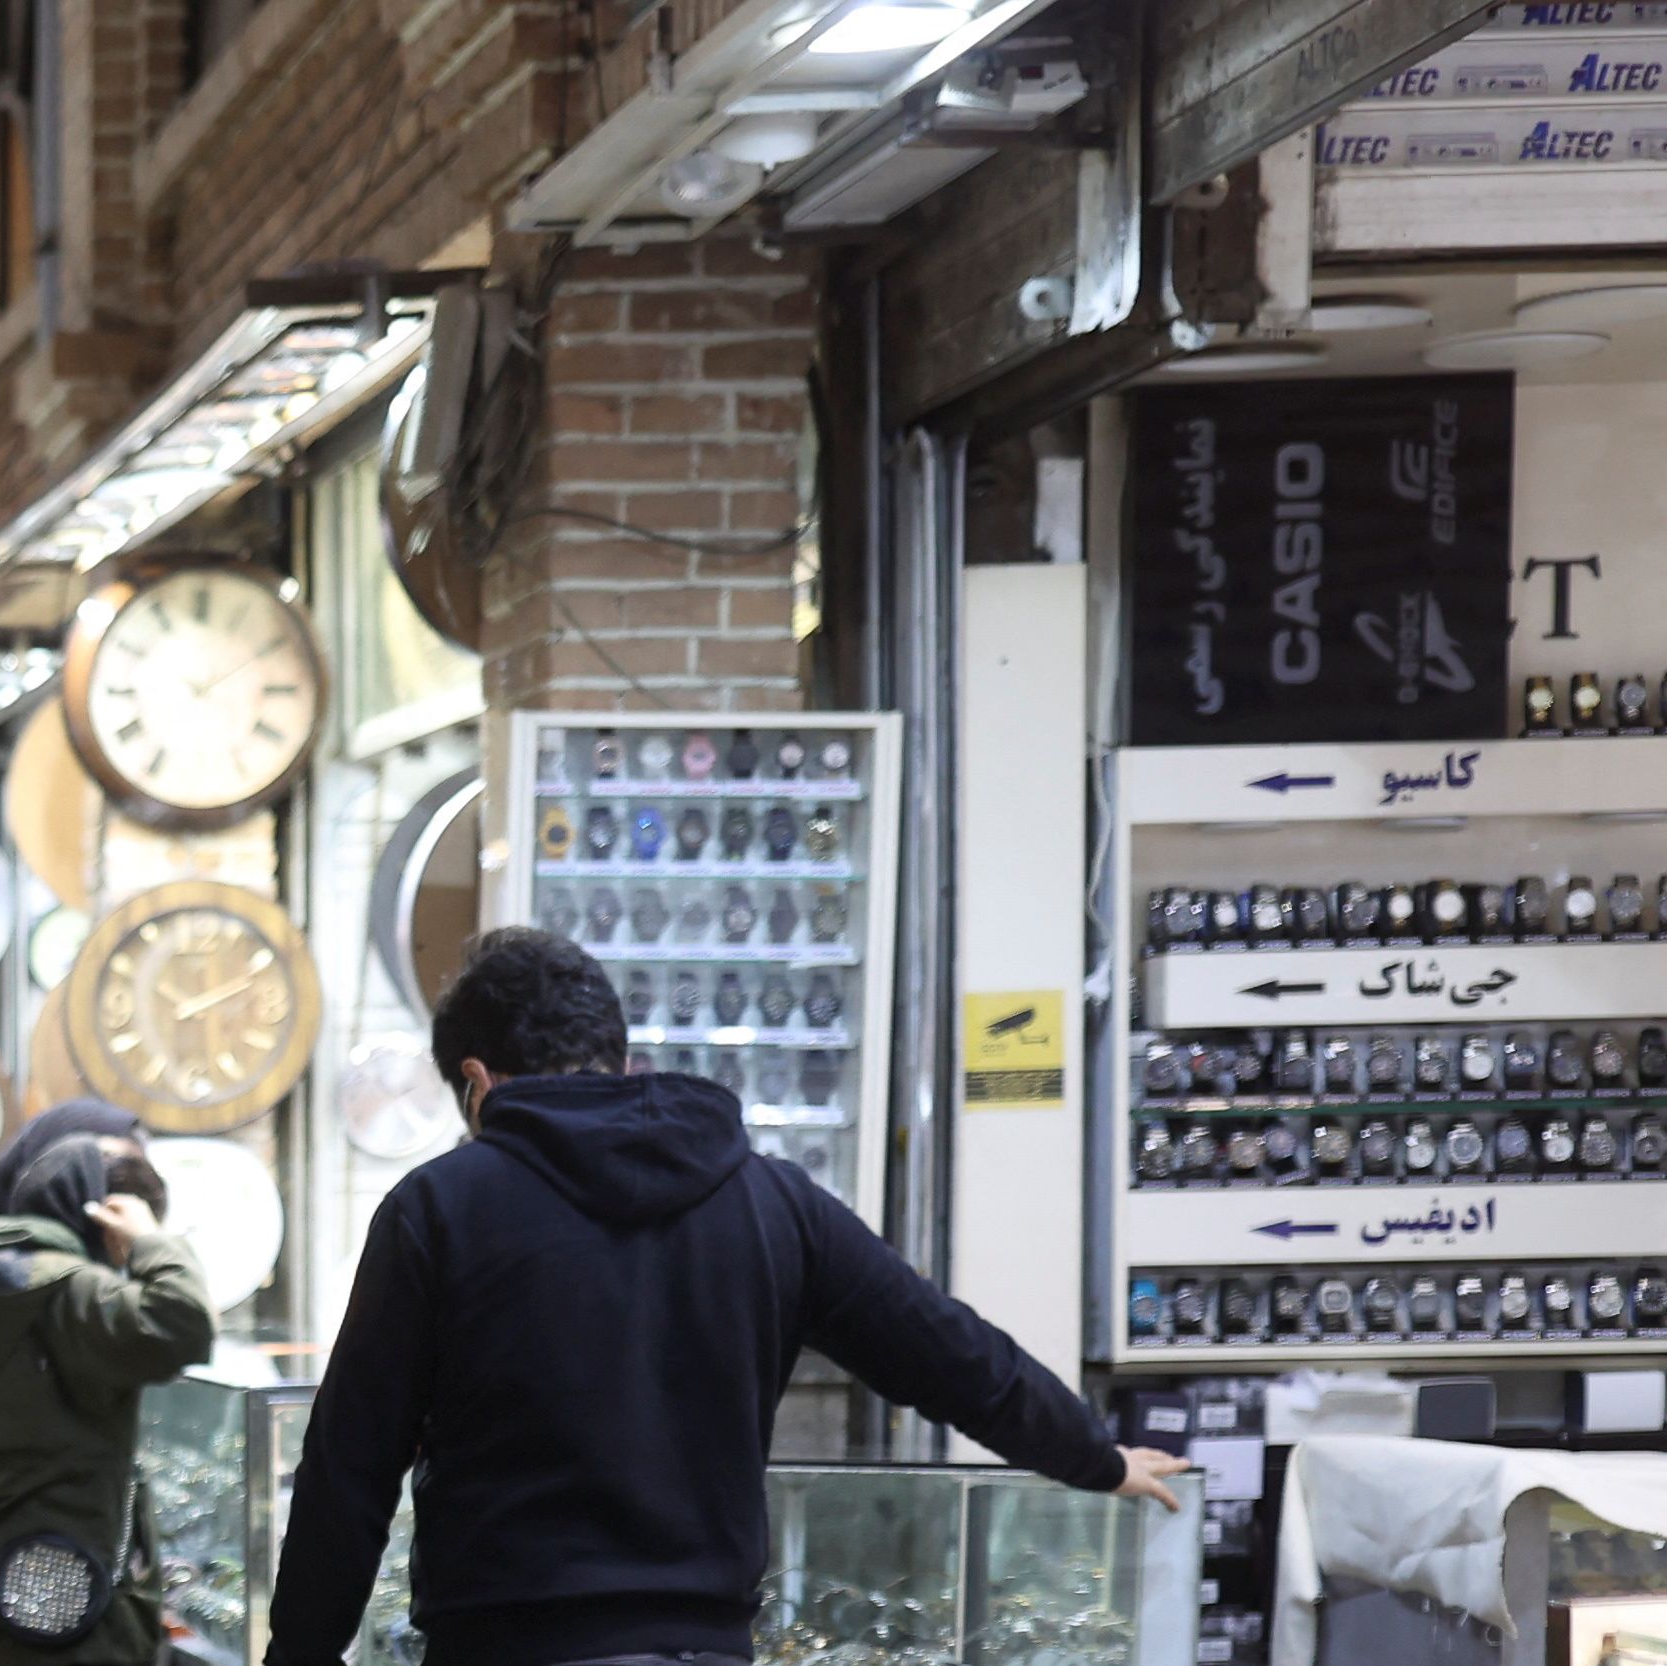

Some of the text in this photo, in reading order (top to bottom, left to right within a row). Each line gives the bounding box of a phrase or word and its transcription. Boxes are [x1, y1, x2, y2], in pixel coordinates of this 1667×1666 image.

[1363, 67, 1440, 97] LTEC
[1568, 52, 1663, 93] ALTEC
[1518, 120, 1614, 162] ALTEC
[1431, 399, 1458, 546] EDIFICE
[1271, 441, 1325, 686] CASIO
[1378, 750, 1482, 806] کاسیو
[1360, 1197, 1496, 1244] ادیفیس
